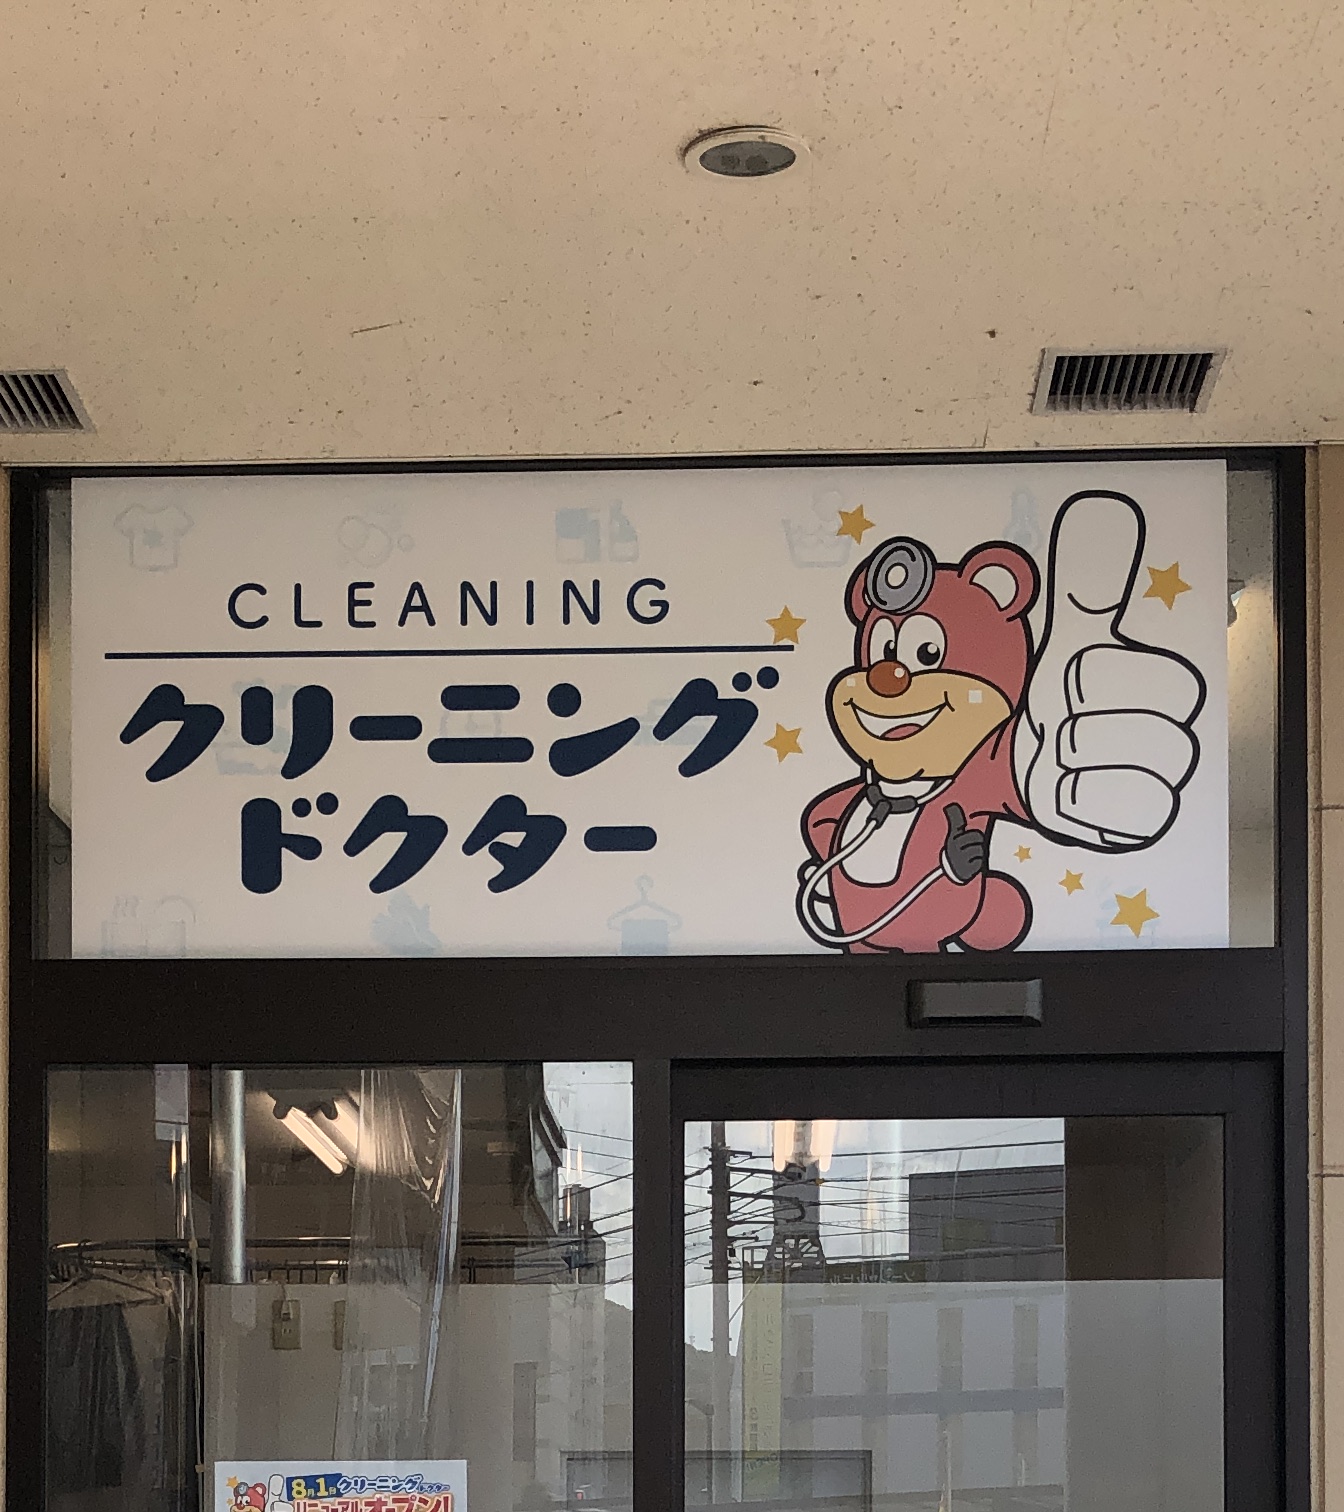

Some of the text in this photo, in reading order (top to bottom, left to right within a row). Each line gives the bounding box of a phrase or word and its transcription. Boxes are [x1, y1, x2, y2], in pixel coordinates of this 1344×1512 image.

[226, 576, 674, 631] CLEANING
[118, 664, 780, 783] クリーニング
[239, 791, 659, 895] ドクター
